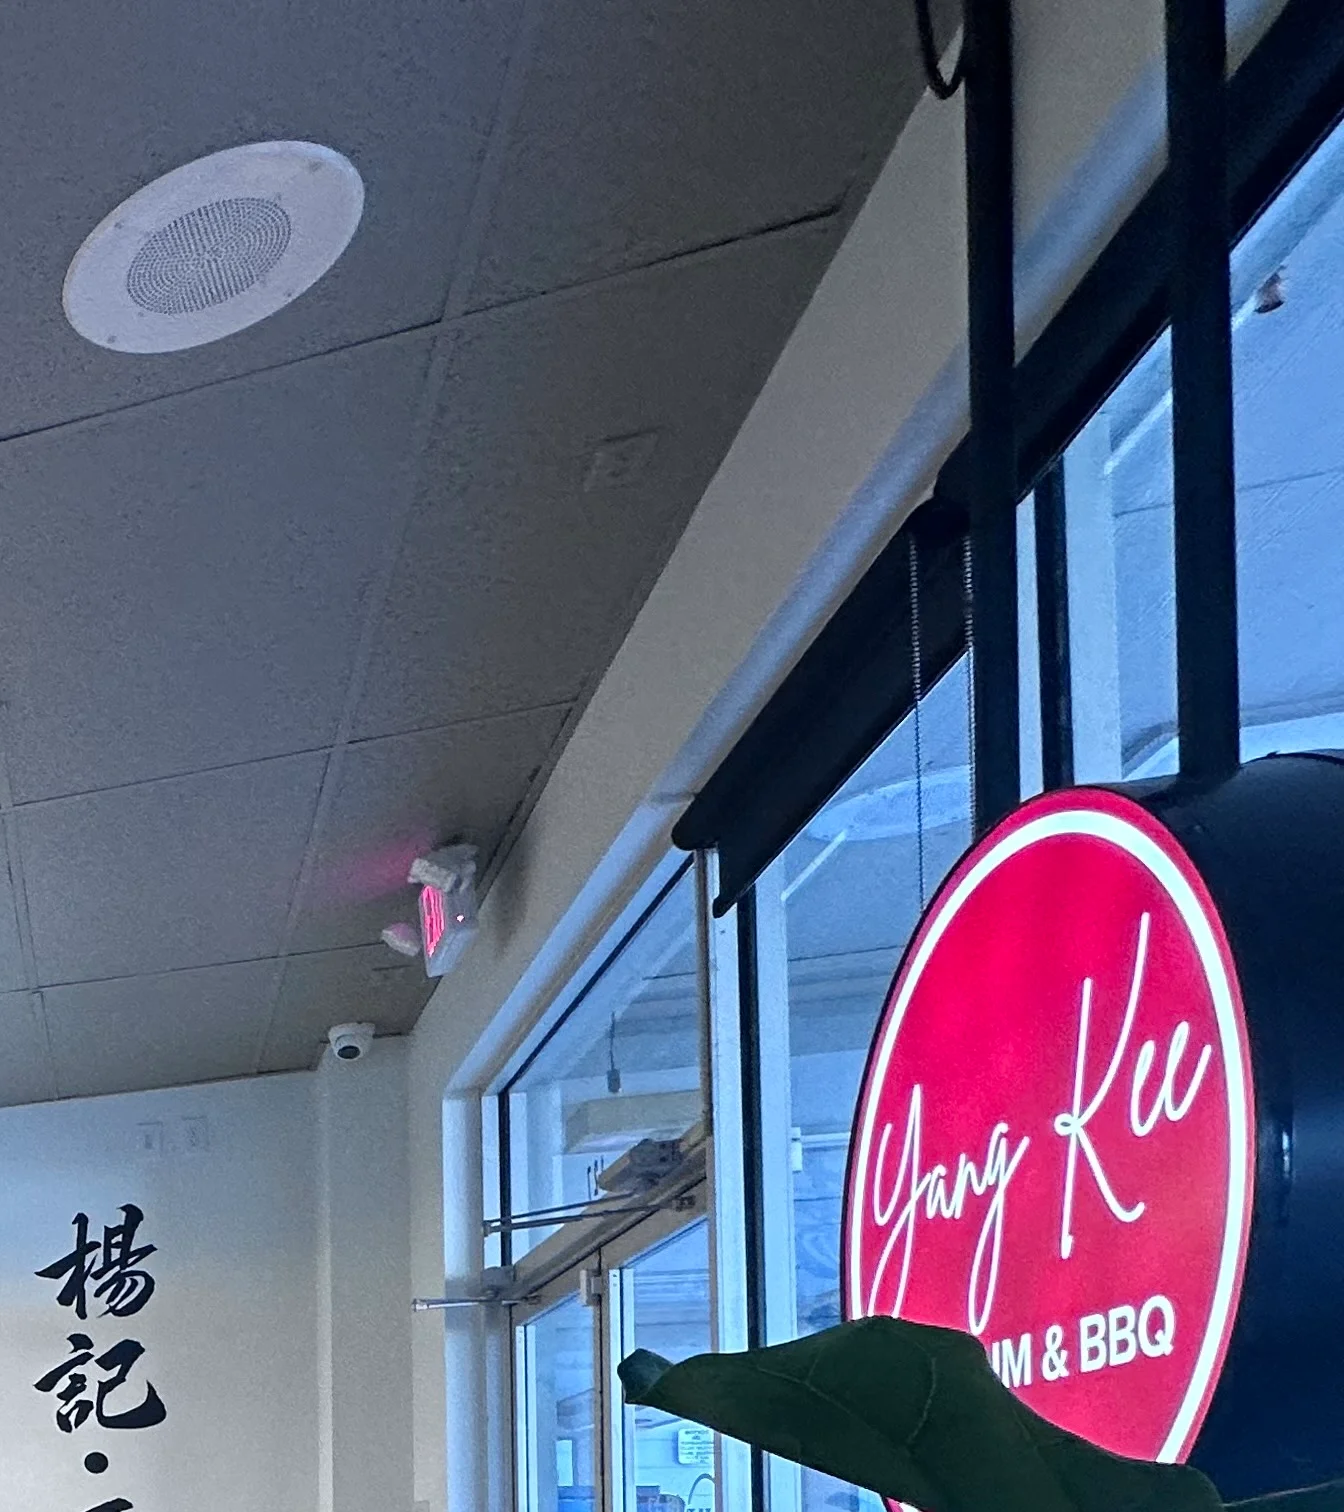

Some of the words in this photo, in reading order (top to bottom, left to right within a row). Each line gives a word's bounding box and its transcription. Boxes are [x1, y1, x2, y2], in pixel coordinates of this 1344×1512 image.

[868, 1083, 1030, 1334] Yang
[1053, 911, 1211, 1259] Kee
[1042, 1324, 1070, 1381] &
[1079, 1294, 1176, 1373] BBQ
